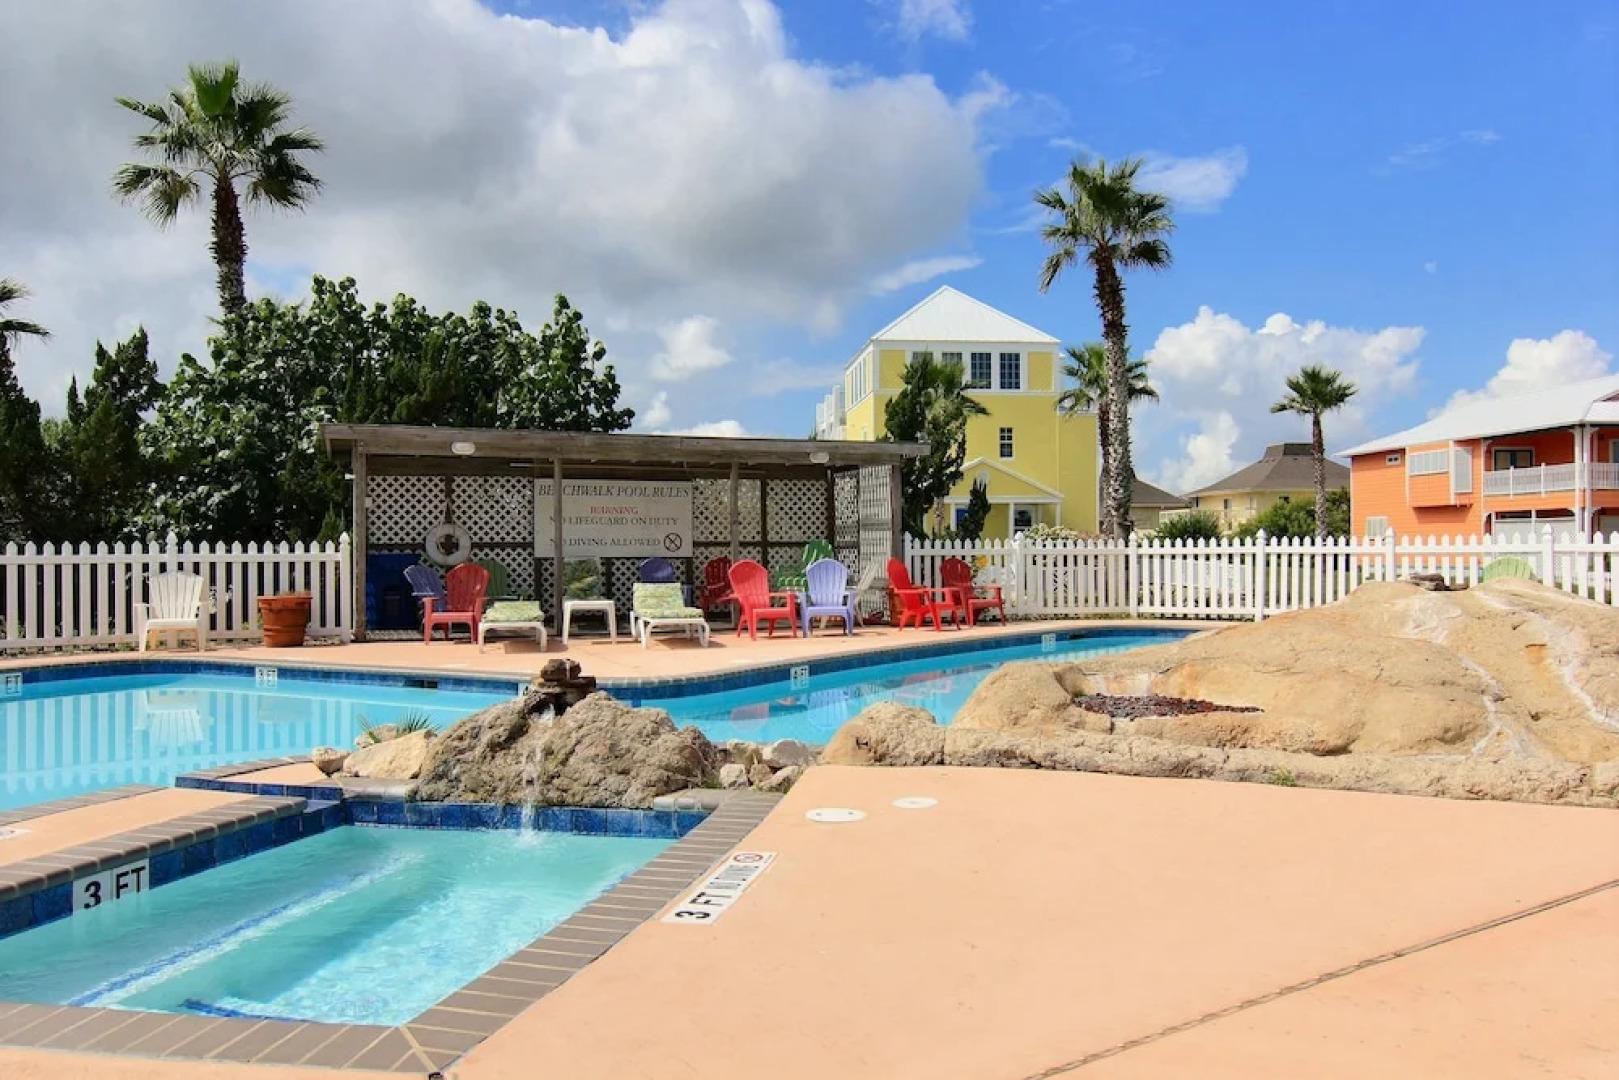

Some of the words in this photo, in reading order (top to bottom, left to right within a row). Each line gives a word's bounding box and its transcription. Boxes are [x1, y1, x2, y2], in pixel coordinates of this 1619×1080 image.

[538, 485, 615, 497] BECHWALK
[617, 485, 650, 498] POOL
[652, 486, 690, 498] RULES
[590, 506, 640, 515] WARNING
[569, 516, 629, 526] LIFEGUARD
[630, 517, 647, 526] ON
[649, 517, 680, 526] DUTY
[569, 538, 608, 547] DIVING
[609, 538, 661, 547] ALLOWED
[83, 880, 102, 909] 3
[115, 865, 147, 900] FT
[688, 892, 733, 907] FT
[674, 911, 711, 919] 3
